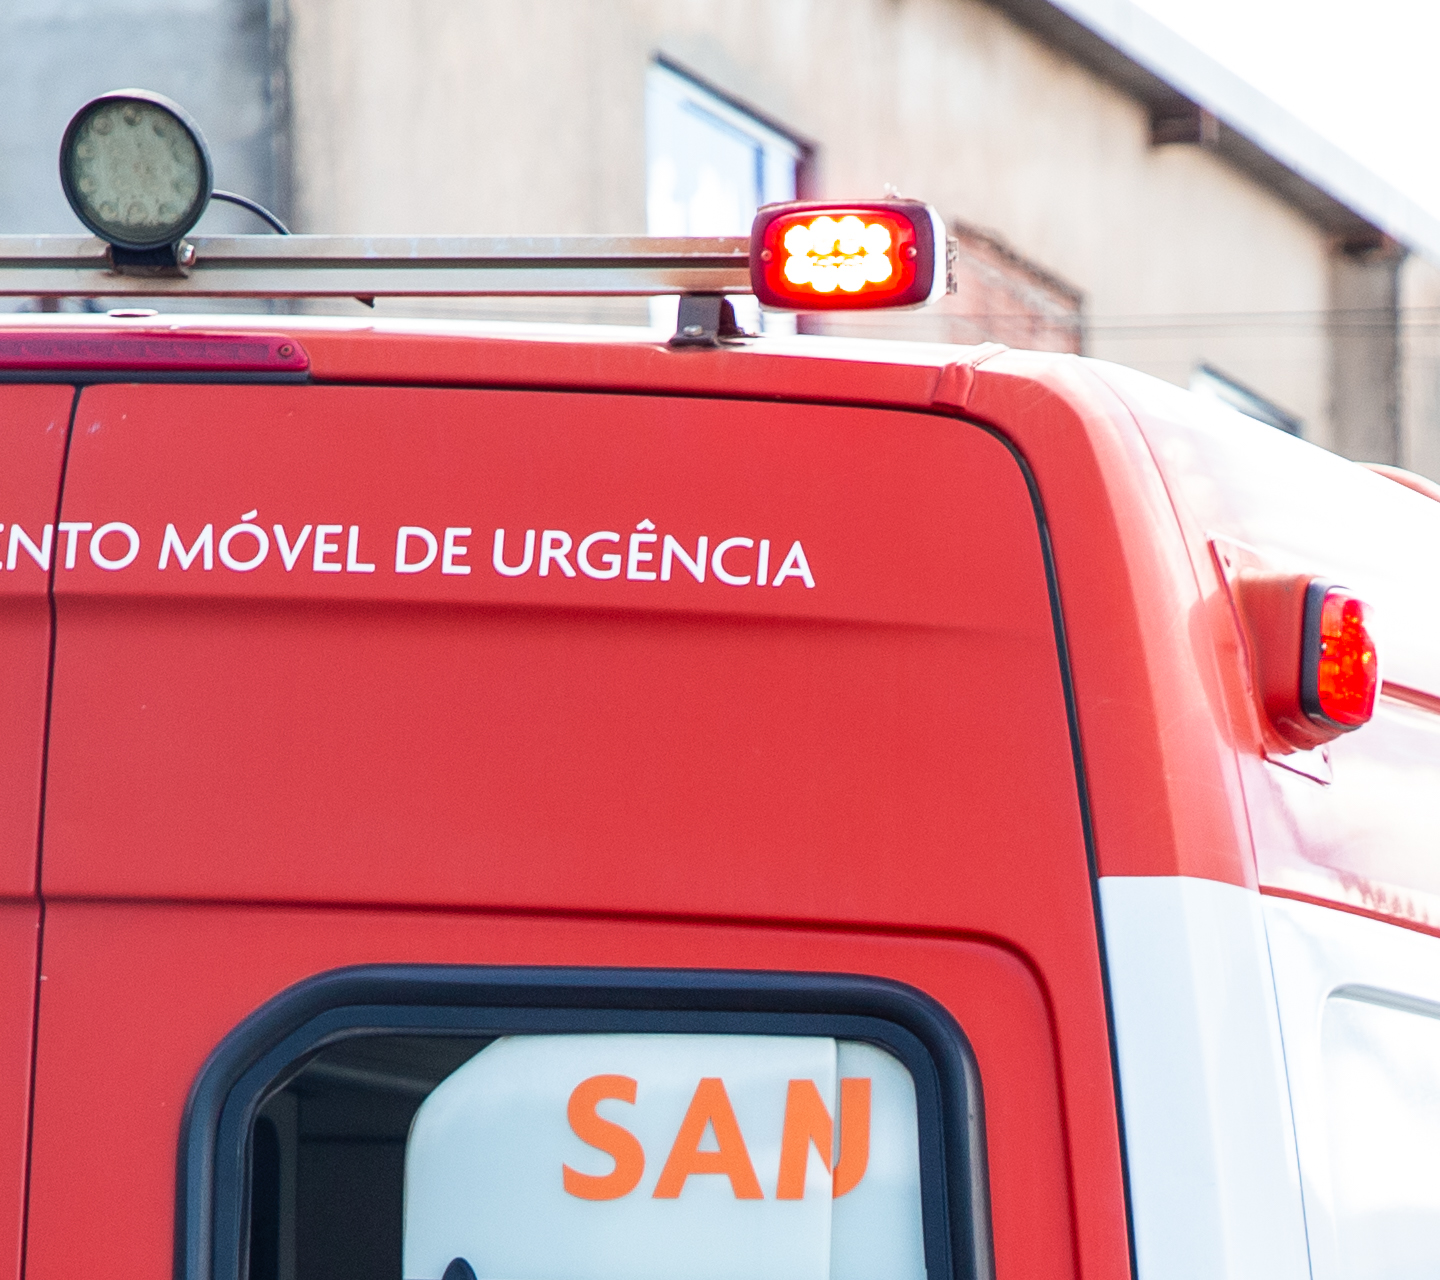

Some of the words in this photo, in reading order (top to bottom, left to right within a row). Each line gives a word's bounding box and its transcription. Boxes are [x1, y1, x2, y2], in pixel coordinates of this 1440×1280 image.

[158, 509, 376, 574] MÓVEL
[394, 525, 473, 577] DE
[492, 518, 817, 589] URGÊNCIA
